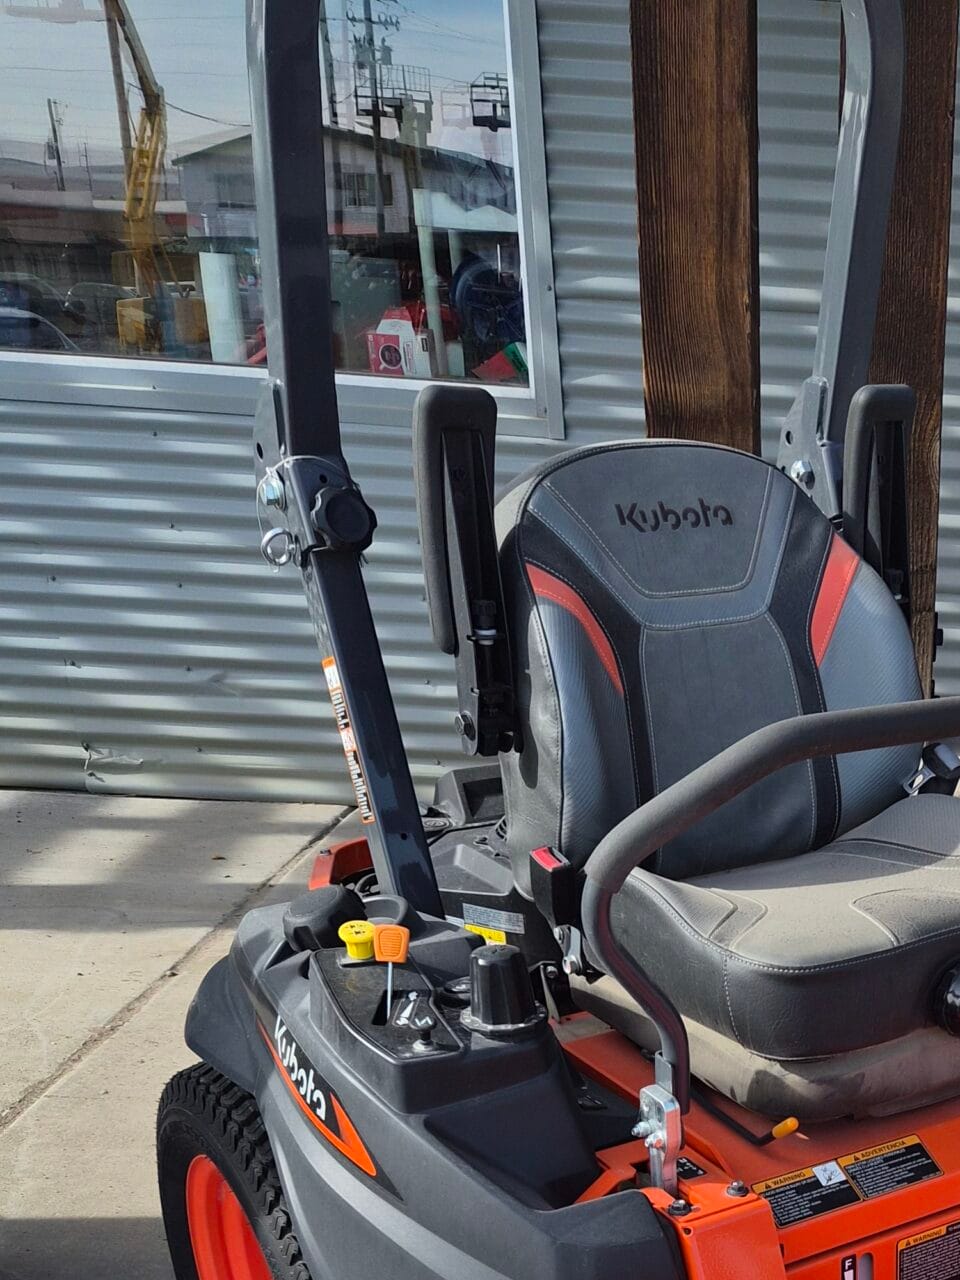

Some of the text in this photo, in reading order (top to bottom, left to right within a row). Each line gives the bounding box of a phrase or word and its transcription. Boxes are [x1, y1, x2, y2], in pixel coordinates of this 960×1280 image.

[614, 497, 733, 533] Kubota
[274, 1014, 327, 1121] Kubota
[859, 1140, 907, 1158] ADVERTENCIA
[771, 1171, 806, 1186] WARNING
[912, 1228, 942, 1244] WARNING
[844, 1258, 853, 1271] F
